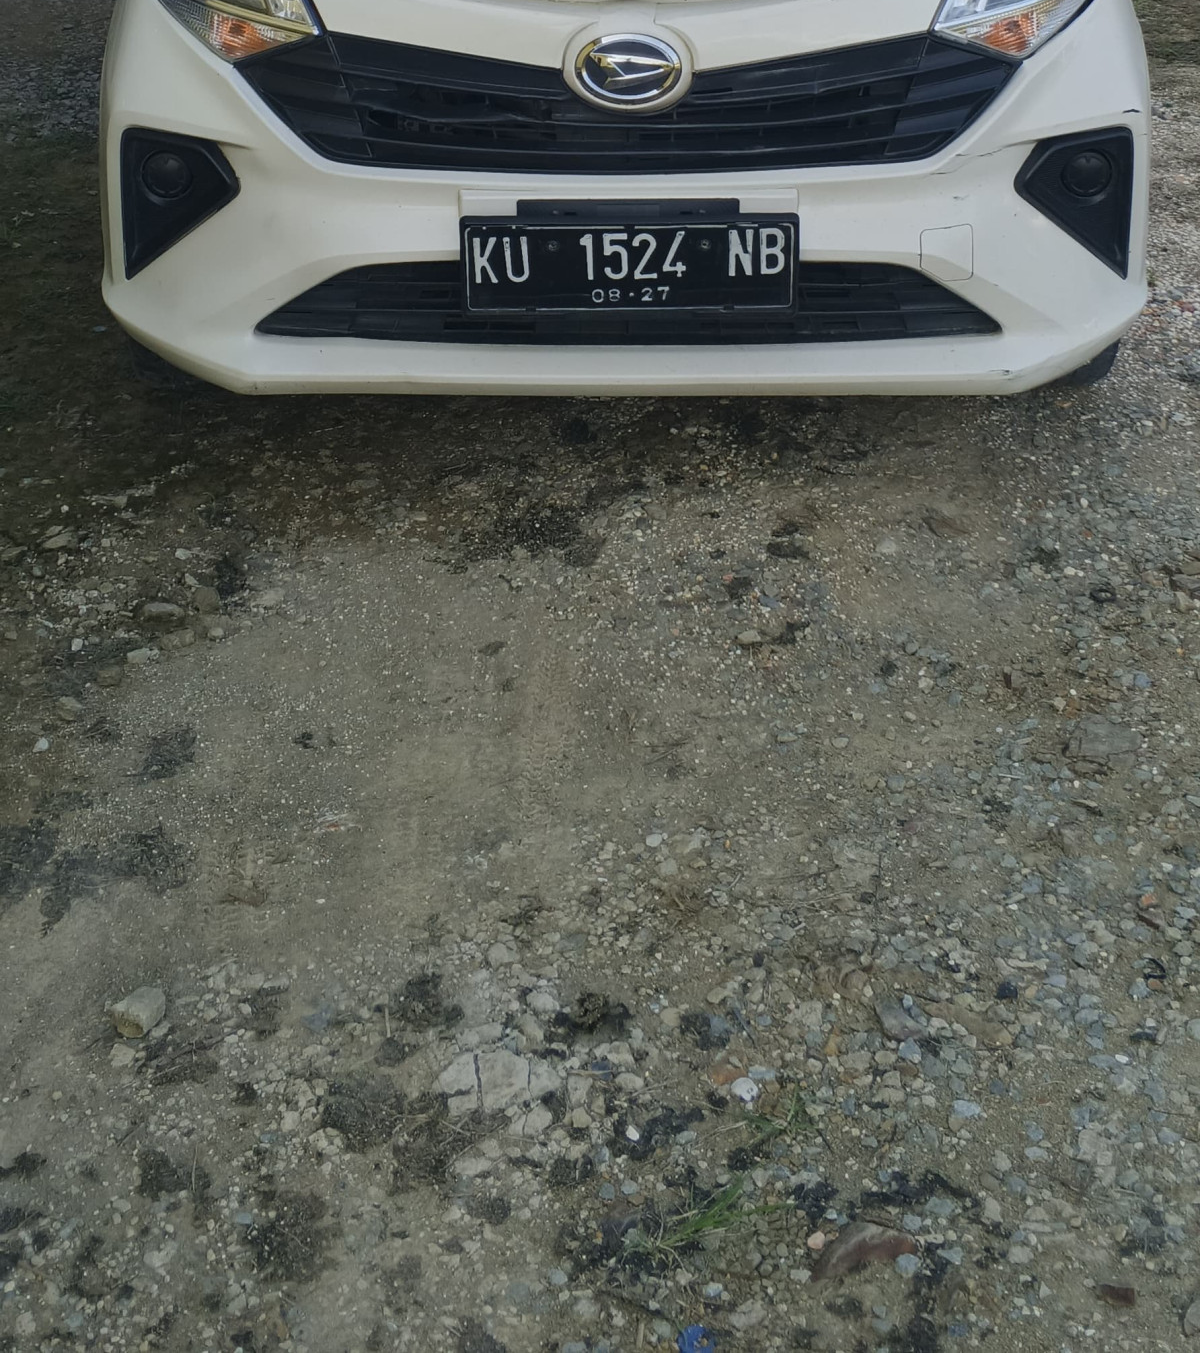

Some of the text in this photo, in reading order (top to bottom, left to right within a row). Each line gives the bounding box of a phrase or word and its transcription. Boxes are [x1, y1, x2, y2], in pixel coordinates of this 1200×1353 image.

[472, 228, 785, 283] KU 1524 NB
